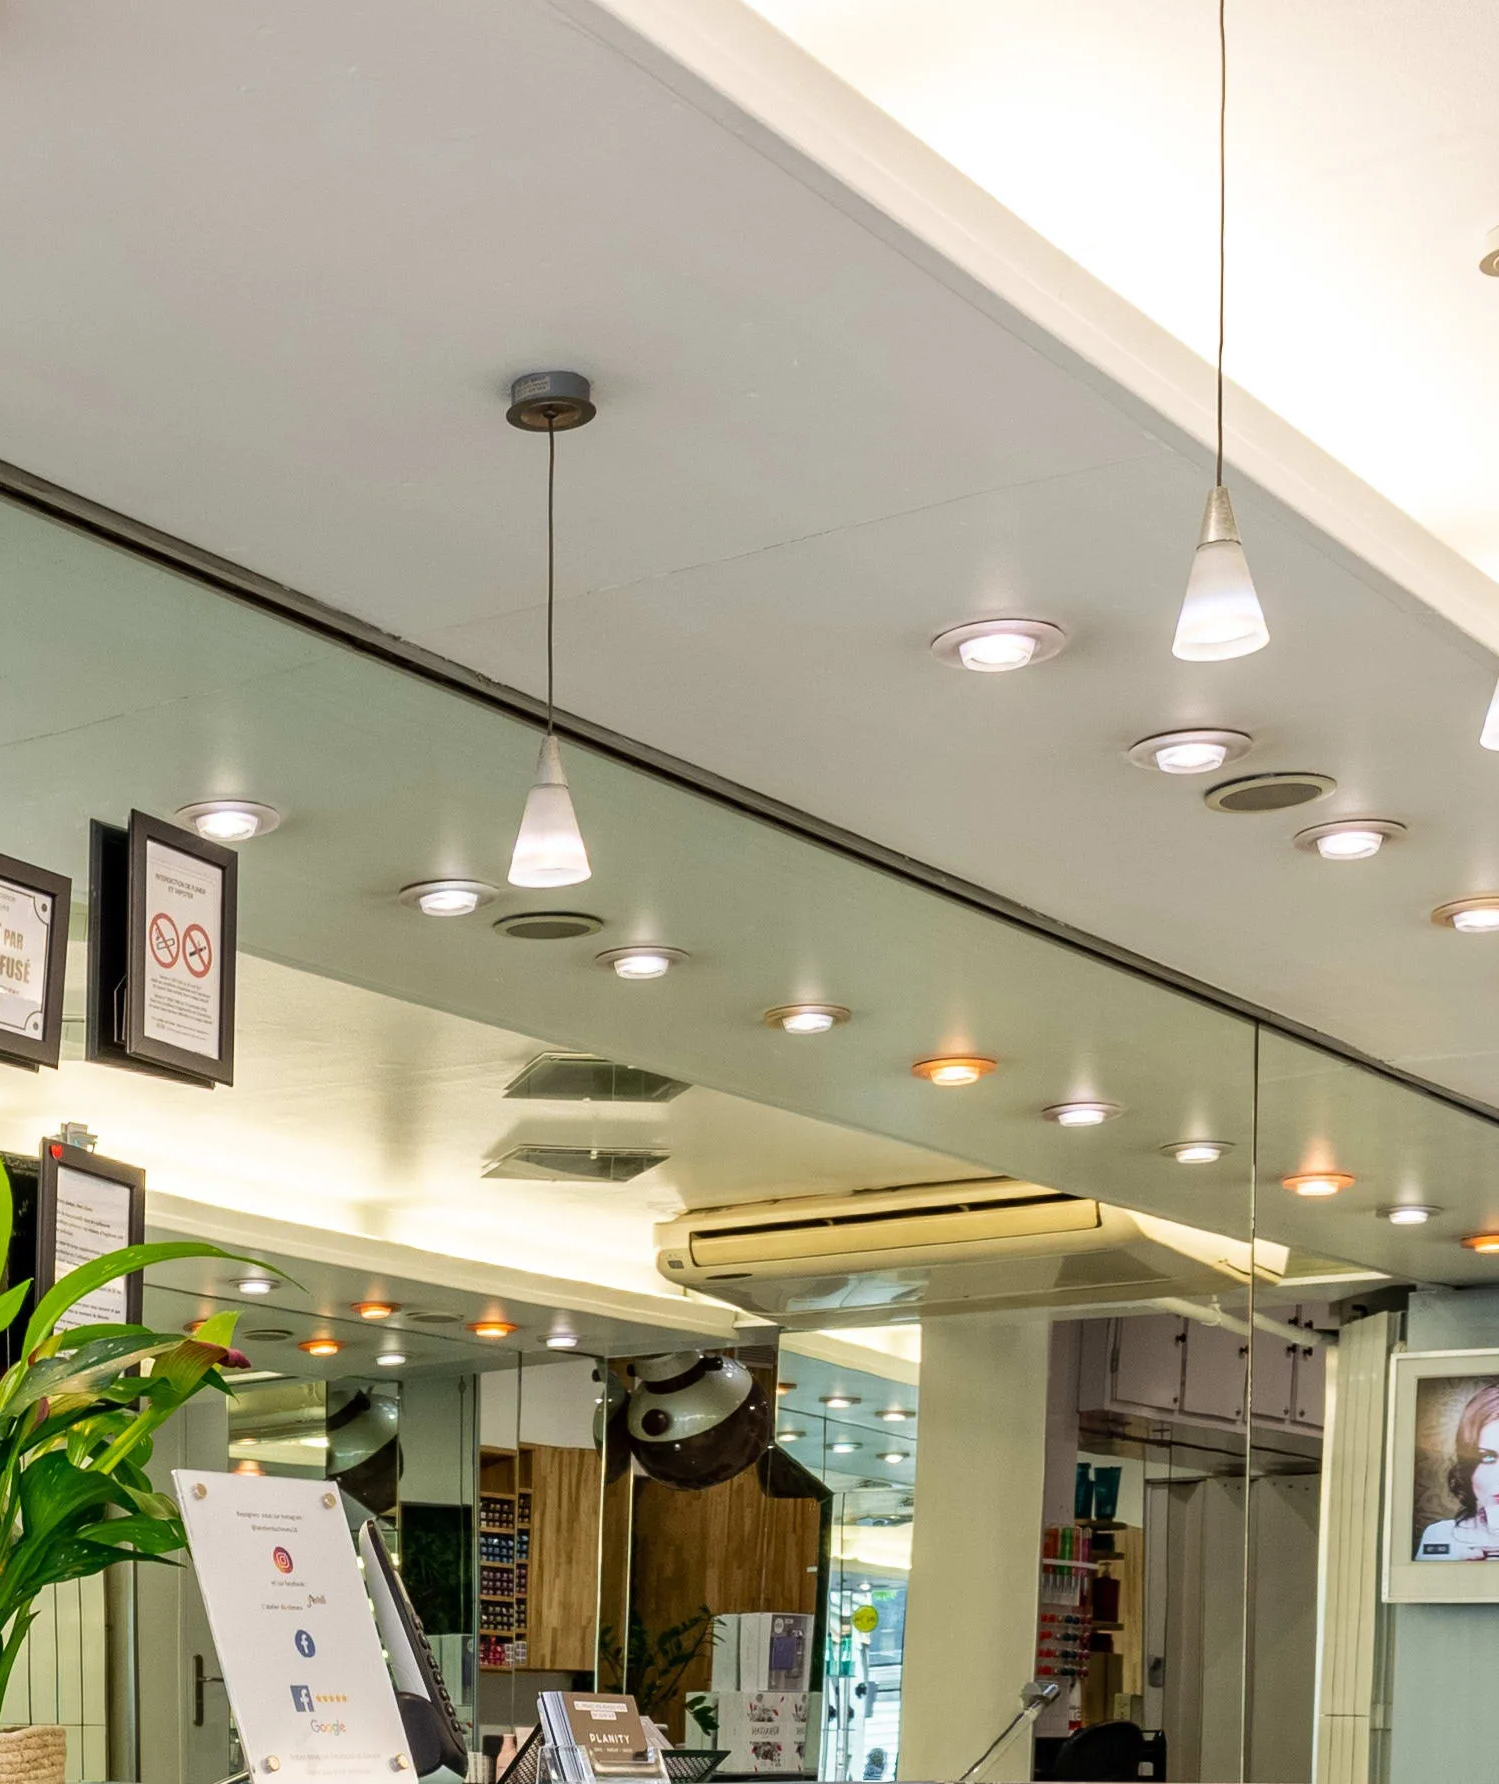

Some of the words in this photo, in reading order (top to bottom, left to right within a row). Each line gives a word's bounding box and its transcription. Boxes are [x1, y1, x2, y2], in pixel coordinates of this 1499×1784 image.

[4, 928, 24, 950] PAR
[310, 1719, 347, 1736] Google
[589, 1733, 630, 1744] PLANITY
